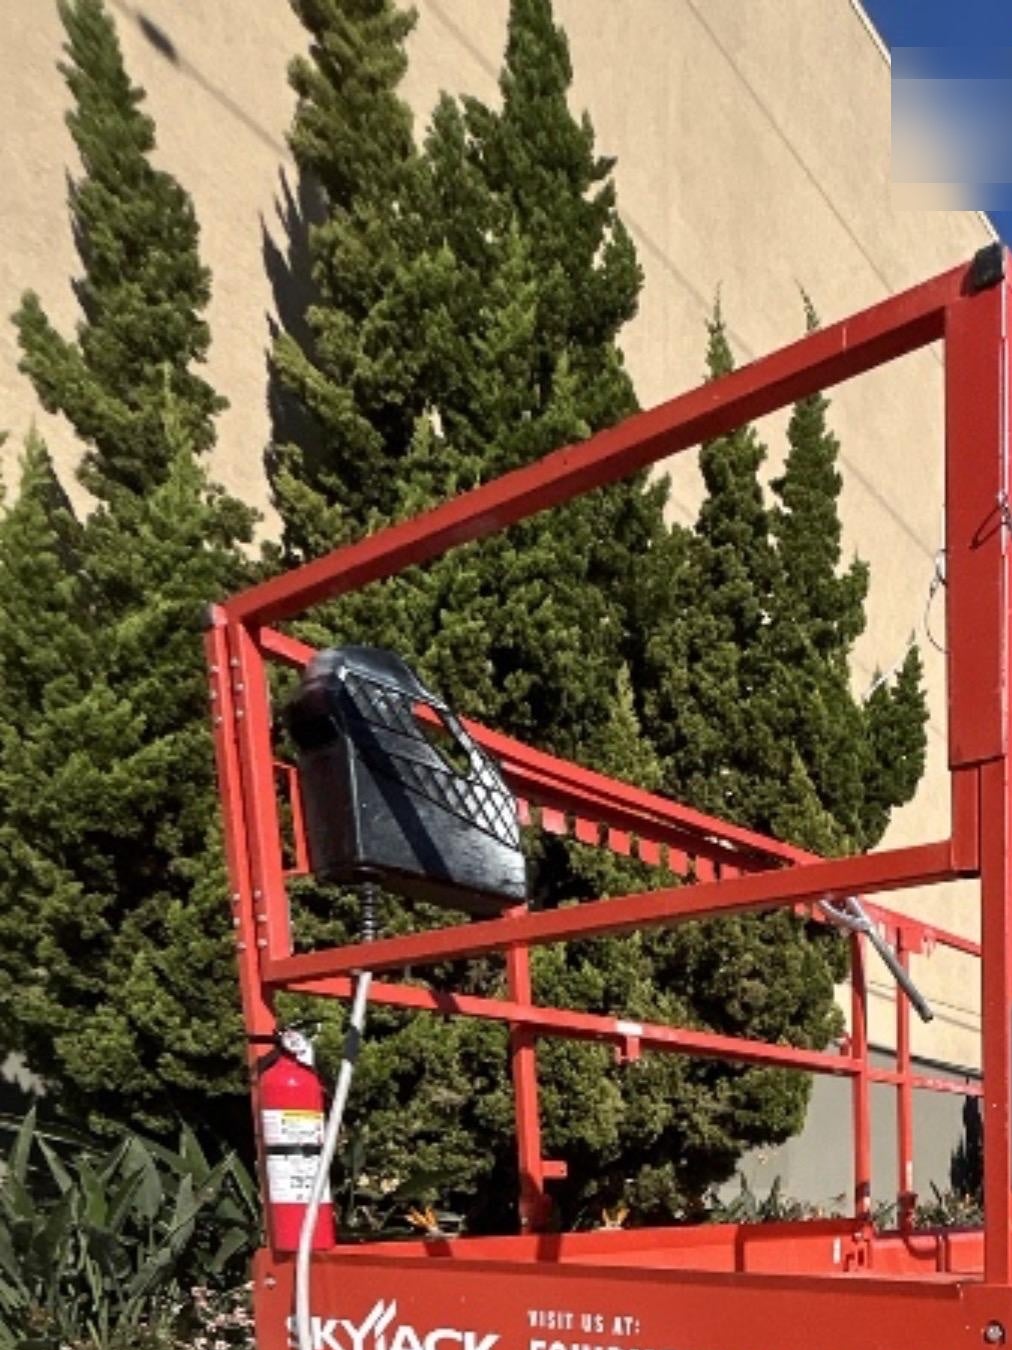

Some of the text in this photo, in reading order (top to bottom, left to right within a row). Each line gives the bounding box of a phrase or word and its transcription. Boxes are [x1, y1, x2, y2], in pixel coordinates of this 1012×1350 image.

[527, 1309, 641, 1336] VISIT US AT:
